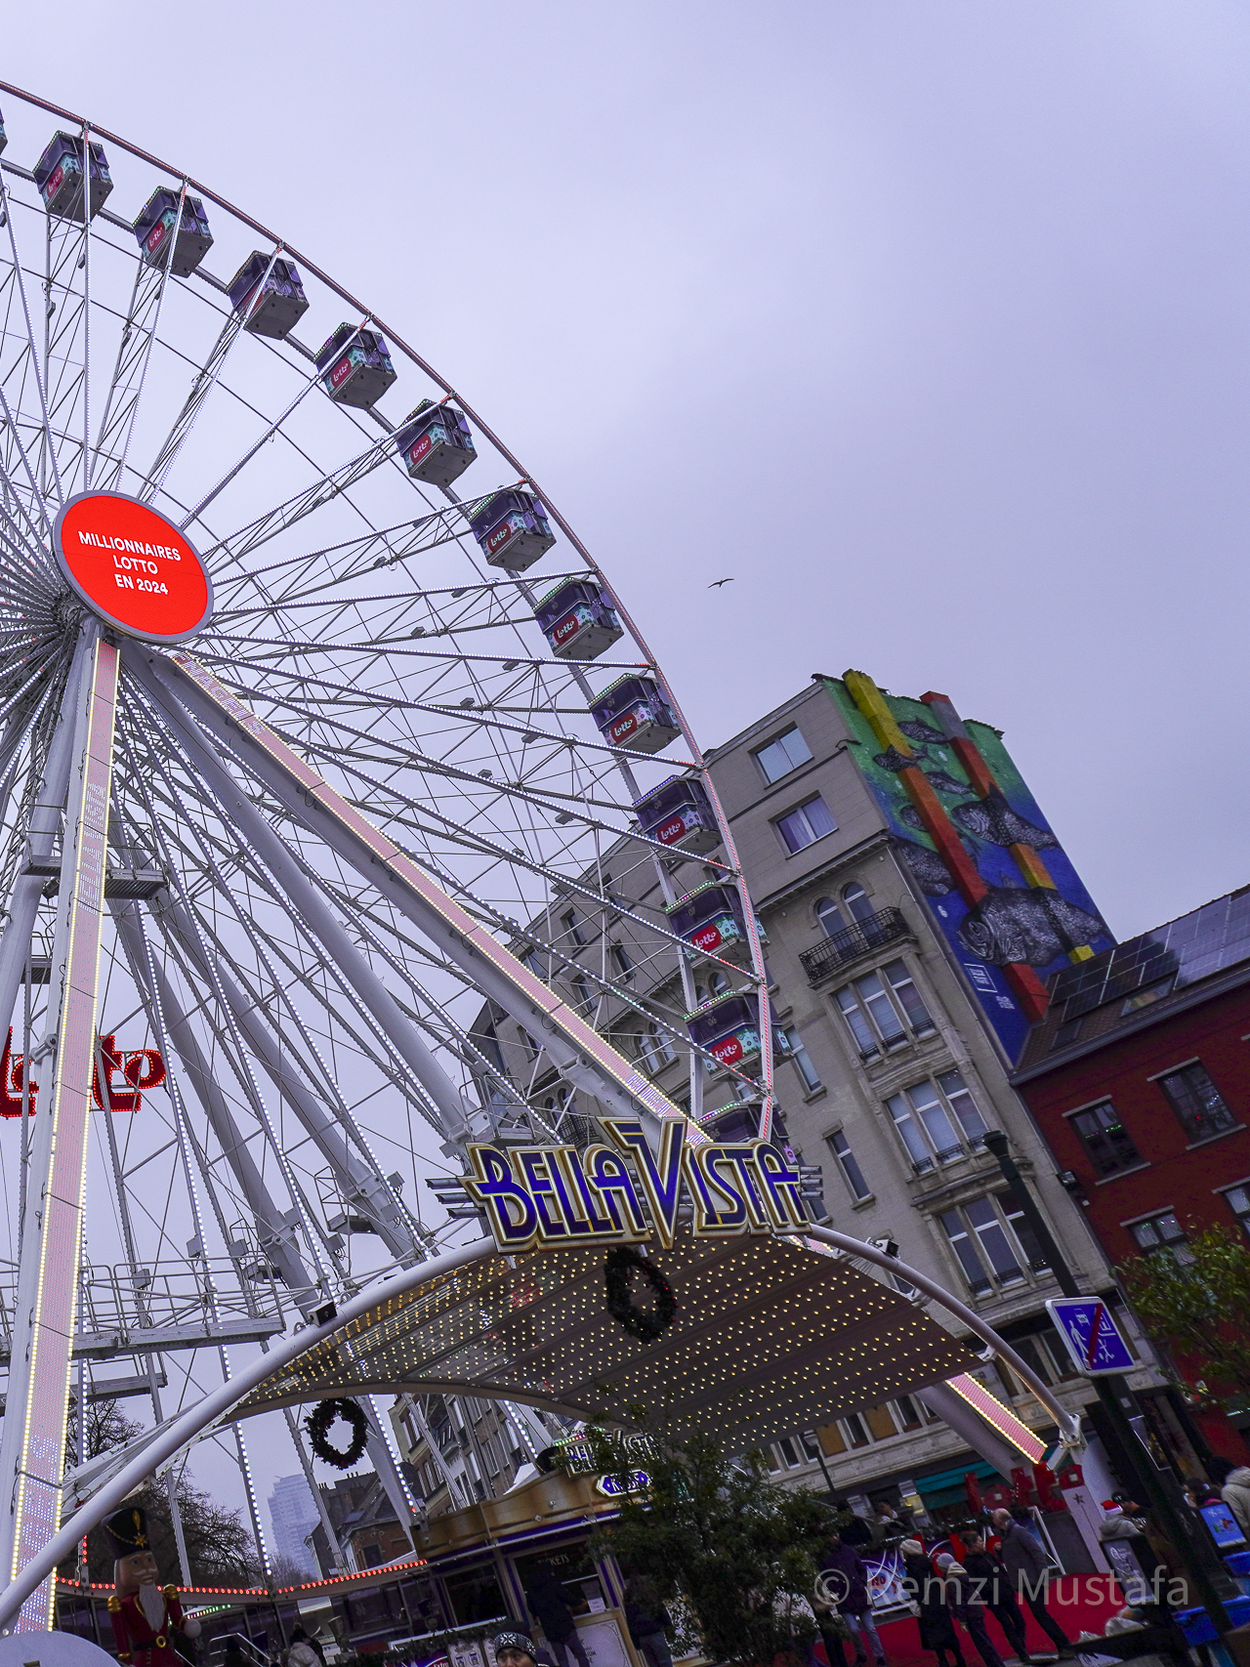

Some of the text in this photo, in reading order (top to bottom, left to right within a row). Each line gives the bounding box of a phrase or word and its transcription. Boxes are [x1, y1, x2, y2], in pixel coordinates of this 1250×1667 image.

[78, 530, 182, 562] MILLIONNAIRES
[113, 555, 158, 575] LOTTO
[115, 574, 169, 595] EN 2024
[470, 1116, 812, 1250] BELLA VISTA
